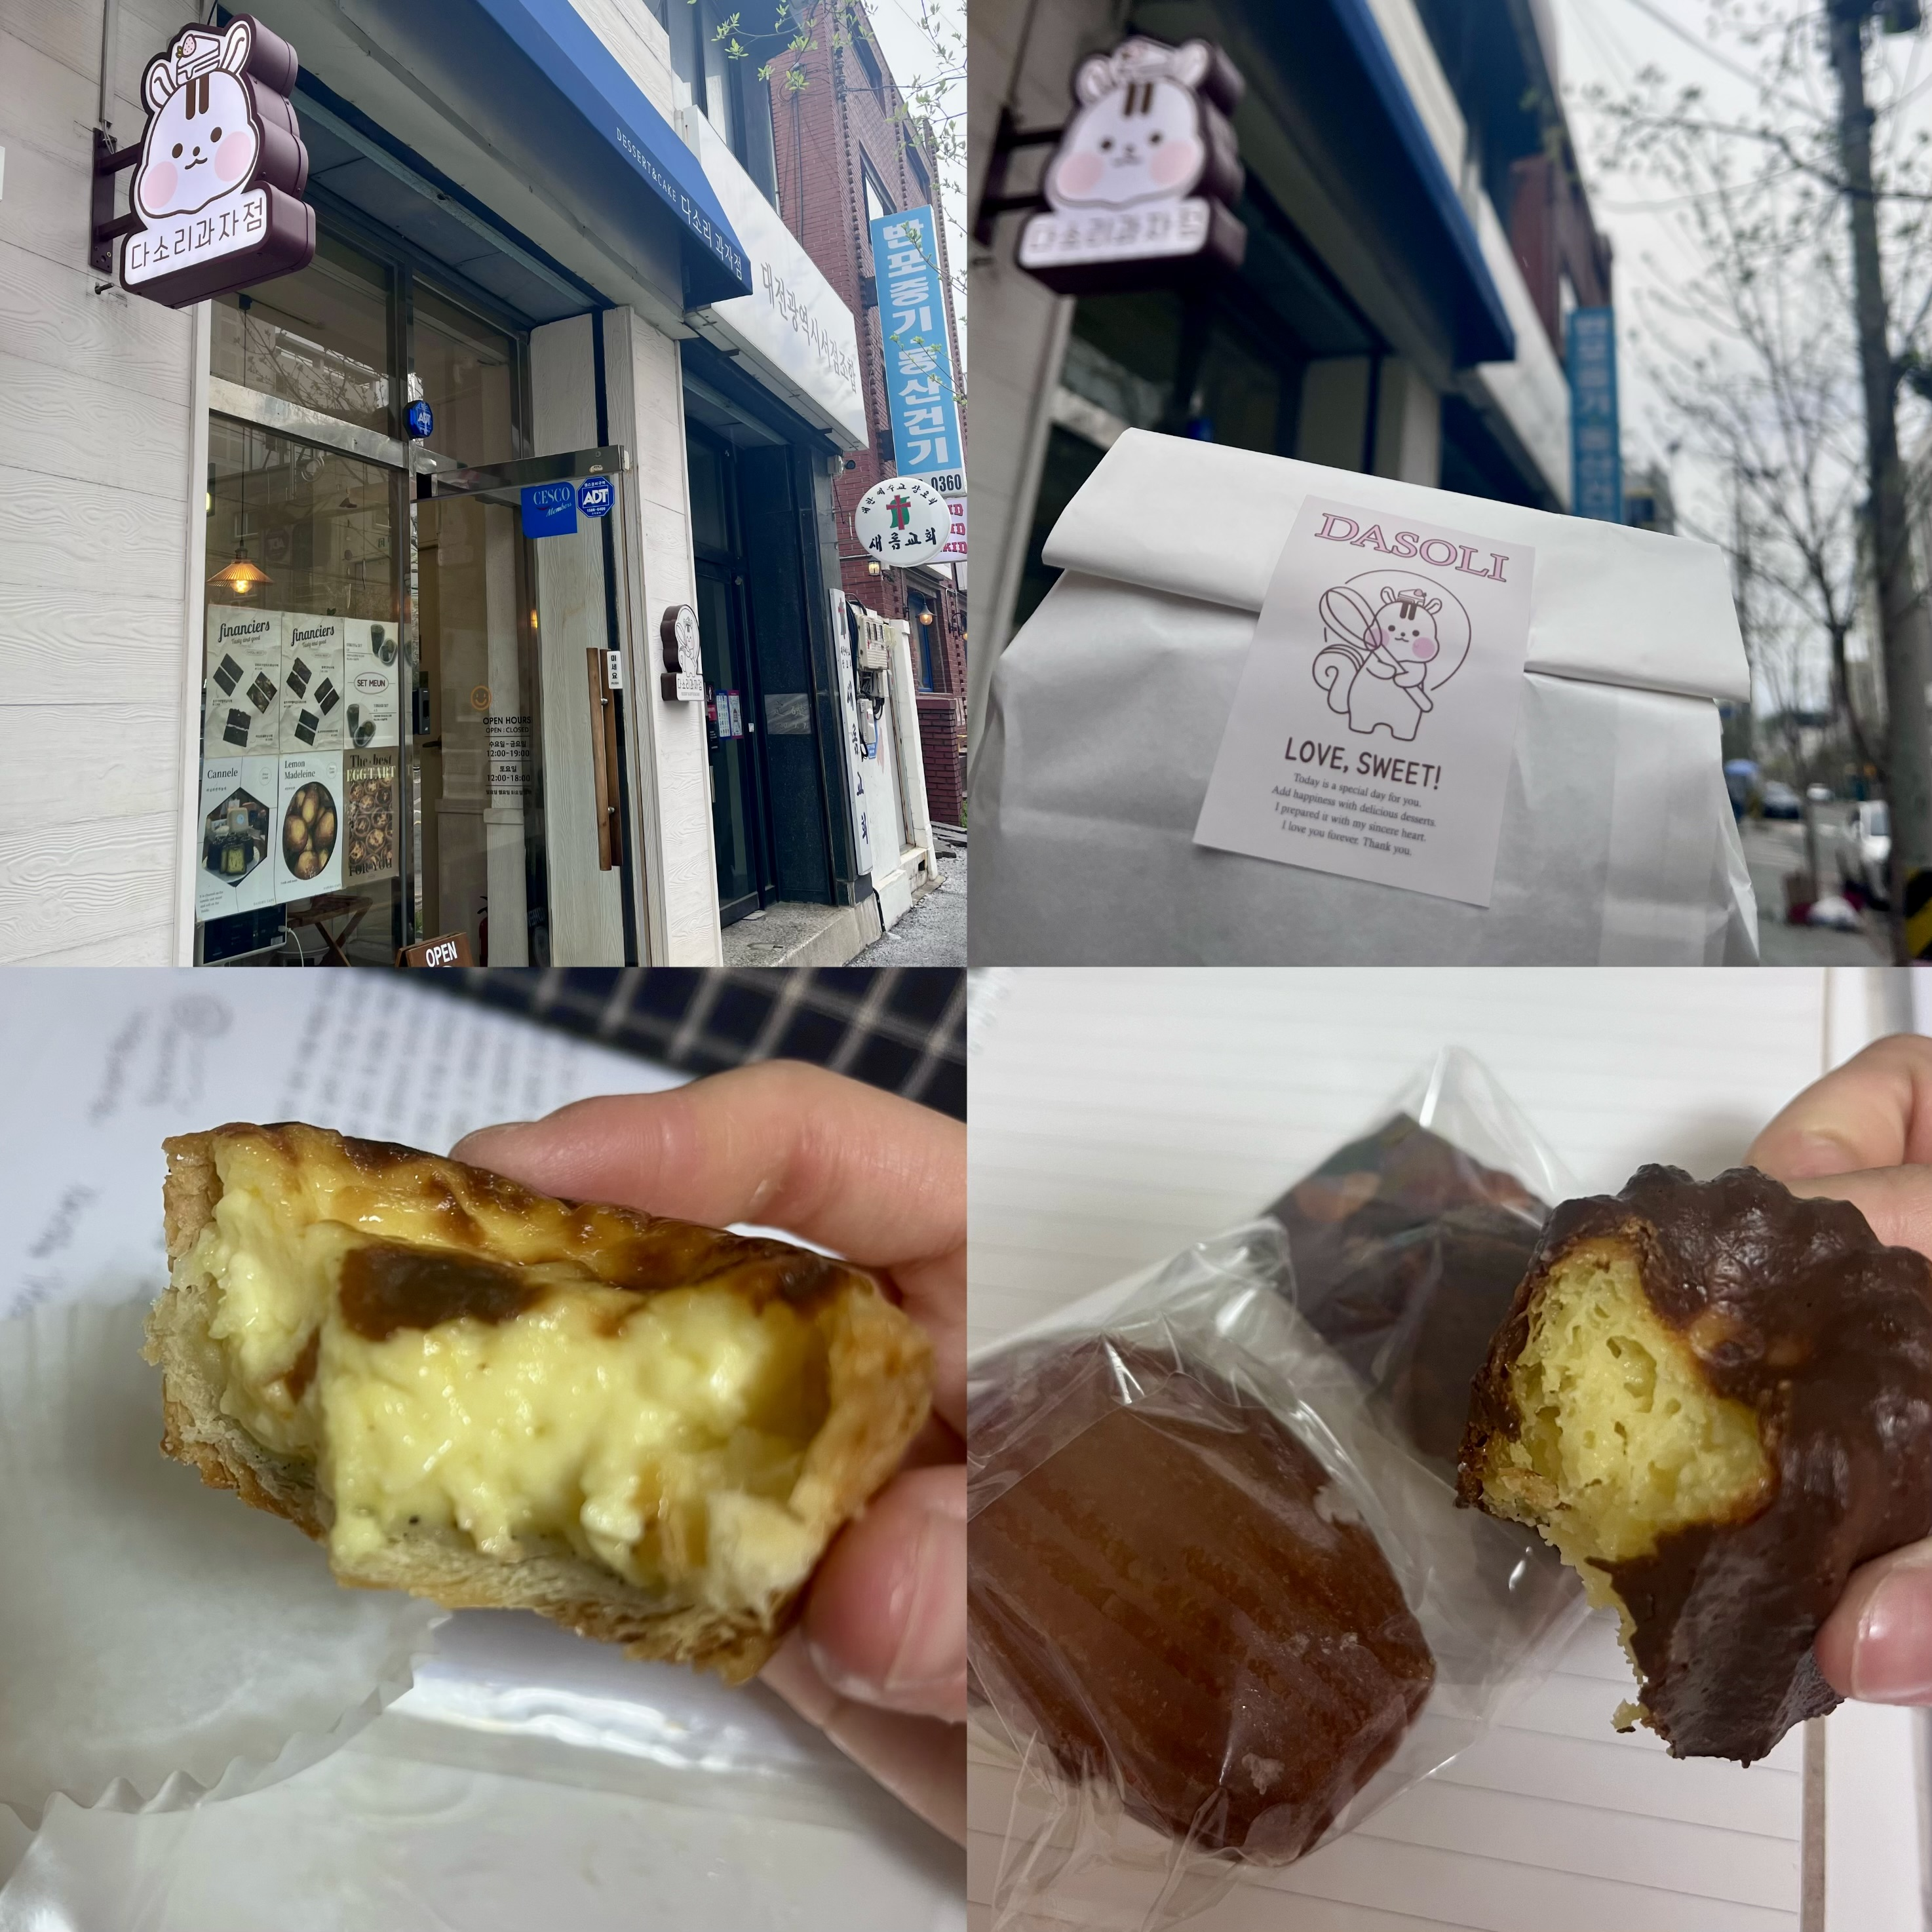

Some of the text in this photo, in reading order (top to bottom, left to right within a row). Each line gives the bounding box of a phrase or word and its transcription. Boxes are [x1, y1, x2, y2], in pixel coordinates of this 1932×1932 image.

[131, 197, 263, 269] 다소리과자점
[680, 195, 712, 248] 다소리
[715, 233, 742, 280] 과자점
[760, 262, 857, 394] 대전광역시서점조합
[417, 412, 431, 425] ADT
[533, 487, 570, 505] CESCO
[583, 488, 609, 505] ADT
[546, 502, 572, 517] Members
[1315, 513, 1509, 583] DASOLI
[218, 619, 270, 643] financiers
[251, 634, 260, 643] good
[290, 625, 334, 647] financiers
[678, 678, 703, 691] 다소리과자점
[285, 760, 305, 769] Lemon
[350, 754, 392, 767] The best
[1285, 737, 1441, 790] LOVE, SWEET!
[207, 767, 238, 779] Cannele
[284, 770, 316, 780] Madeleine
[1294, 773, 1320, 788] Today
[1323, 779, 1329, 788] is
[1339, 784, 1368, 796] special
[1370, 789, 1385, 802] day
[1388, 792, 1401, 803] for
[1402, 798, 1421, 807] you.
[1271, 785, 1436, 826] Add happiness with delicious desserts.
[1275, 802, 1426, 841] I prepared it with my sincere heart.
[1282, 820, 1412, 856] I love you forever. Thank you.
[425, 940, 457, 967] OPEN
